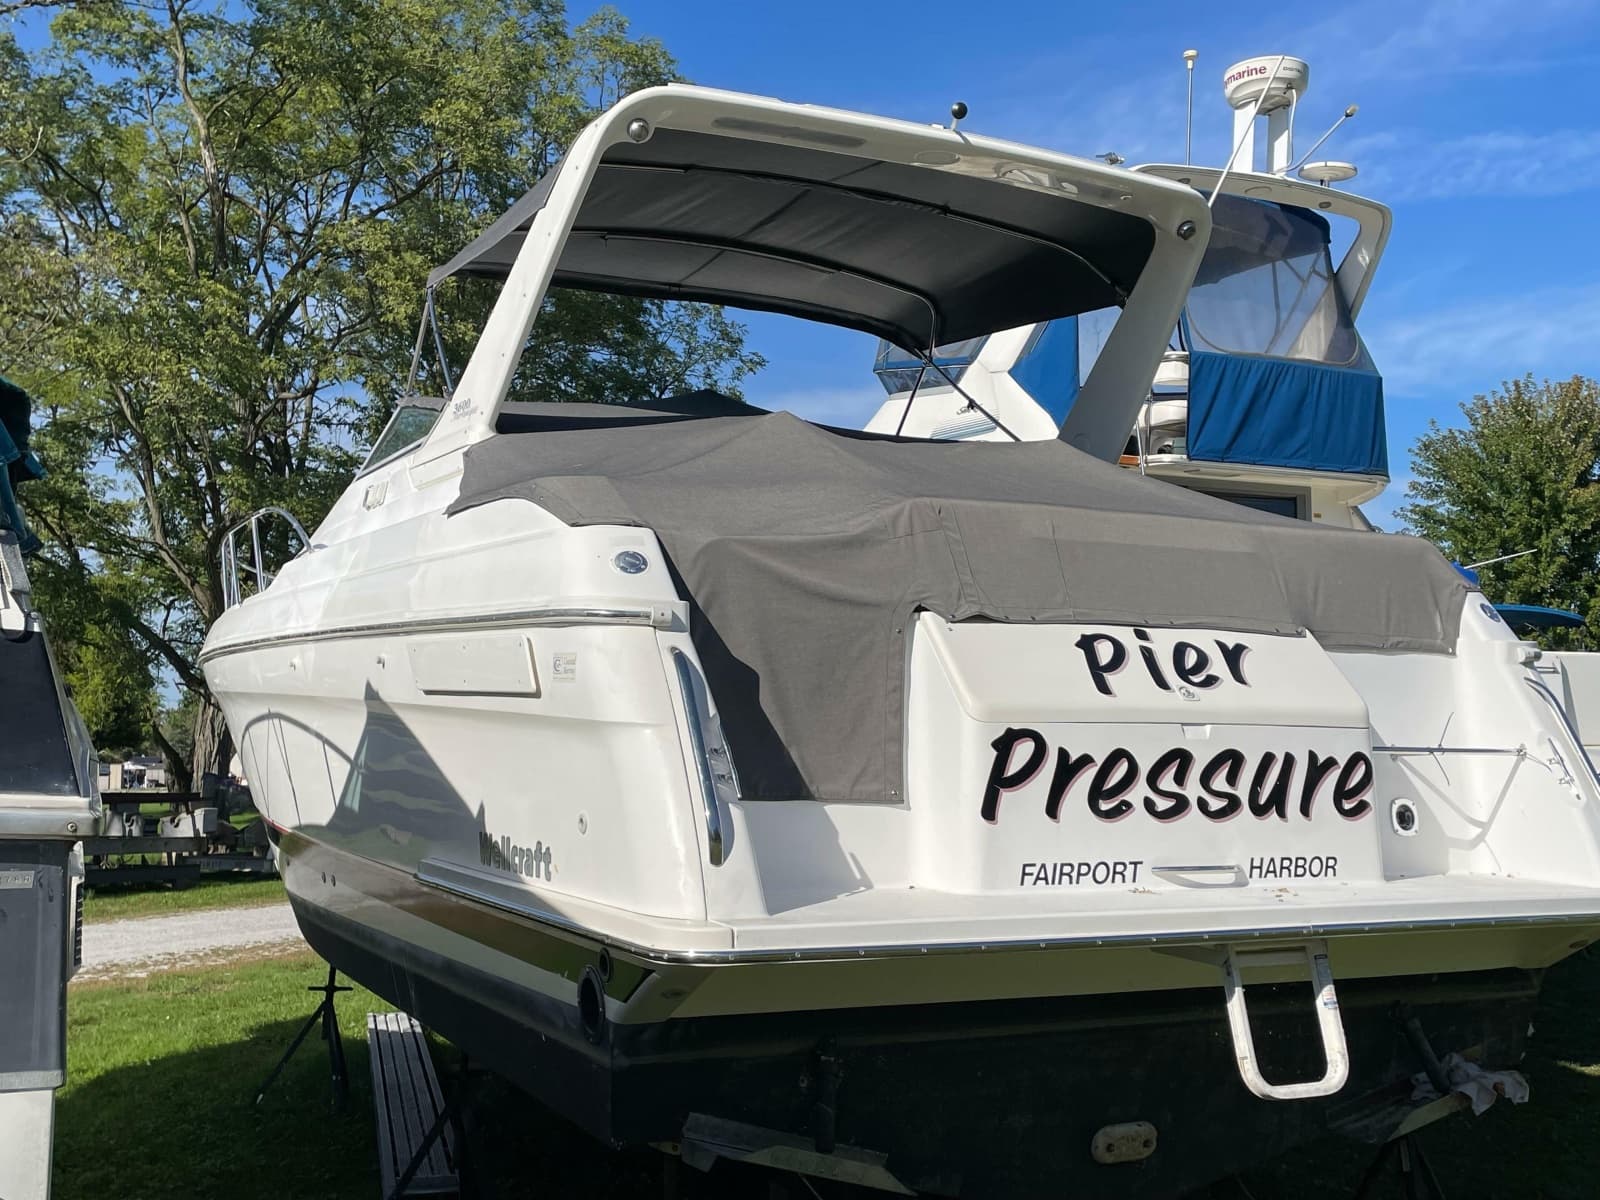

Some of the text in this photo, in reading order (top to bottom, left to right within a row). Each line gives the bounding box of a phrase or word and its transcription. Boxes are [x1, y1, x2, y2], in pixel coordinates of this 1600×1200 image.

[1075, 628, 1252, 696] Pier
[980, 727, 1374, 825] Pressure
[479, 831, 552, 882] Wellcraft
[1019, 855, 1338, 887] FAIRPORT HARBOR
